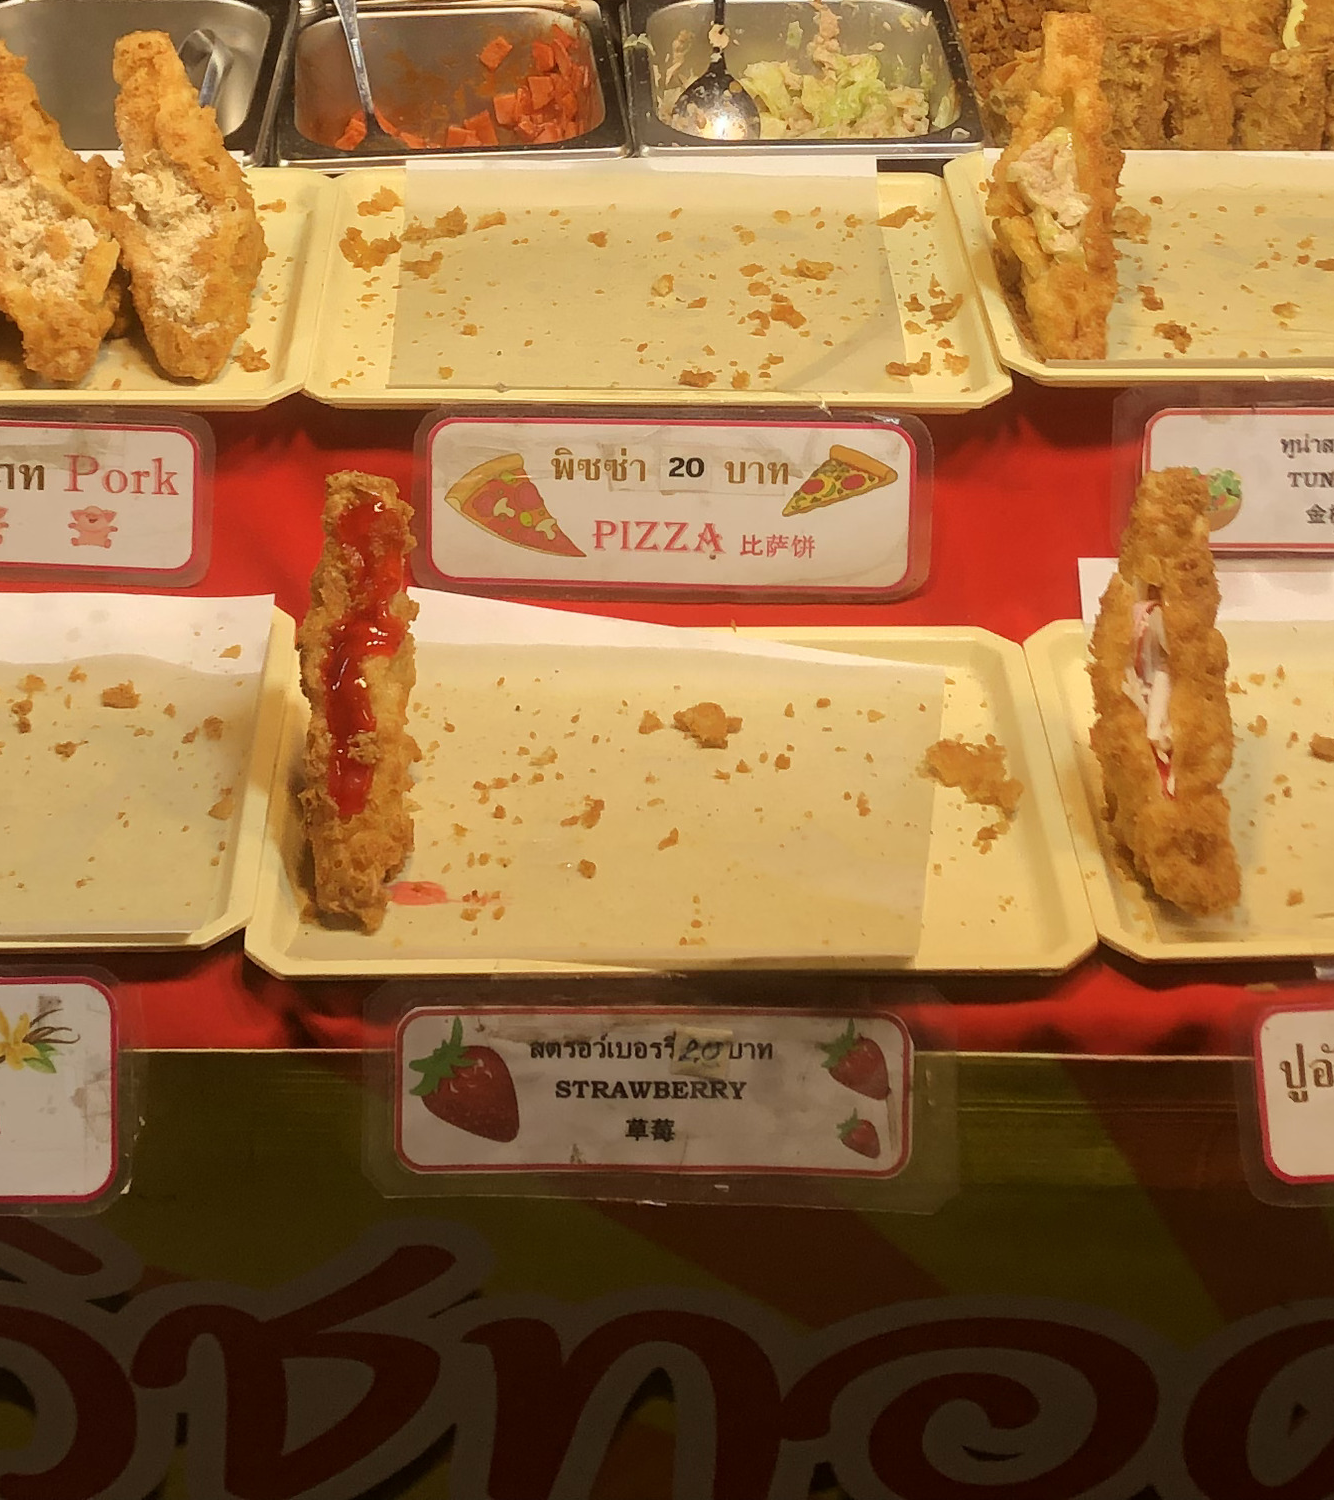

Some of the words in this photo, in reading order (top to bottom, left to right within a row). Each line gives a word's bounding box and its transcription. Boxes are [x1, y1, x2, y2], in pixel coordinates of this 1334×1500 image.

[63, 453, 180, 496] Pork
[550, 446, 647, 482] พิซซ่า
[667, 456, 706, 479] 20
[723, 460, 790, 486] บาท
[592, 518, 726, 554] PIZZA
[739, 534, 816, 559] 比萨饼
[677, 1037, 724, 1065] 20
[728, 1041, 774, 1061] บาท
[554, 1079, 747, 1100] STRAWBERRY
[624, 1117, 676, 1143] 草莓
